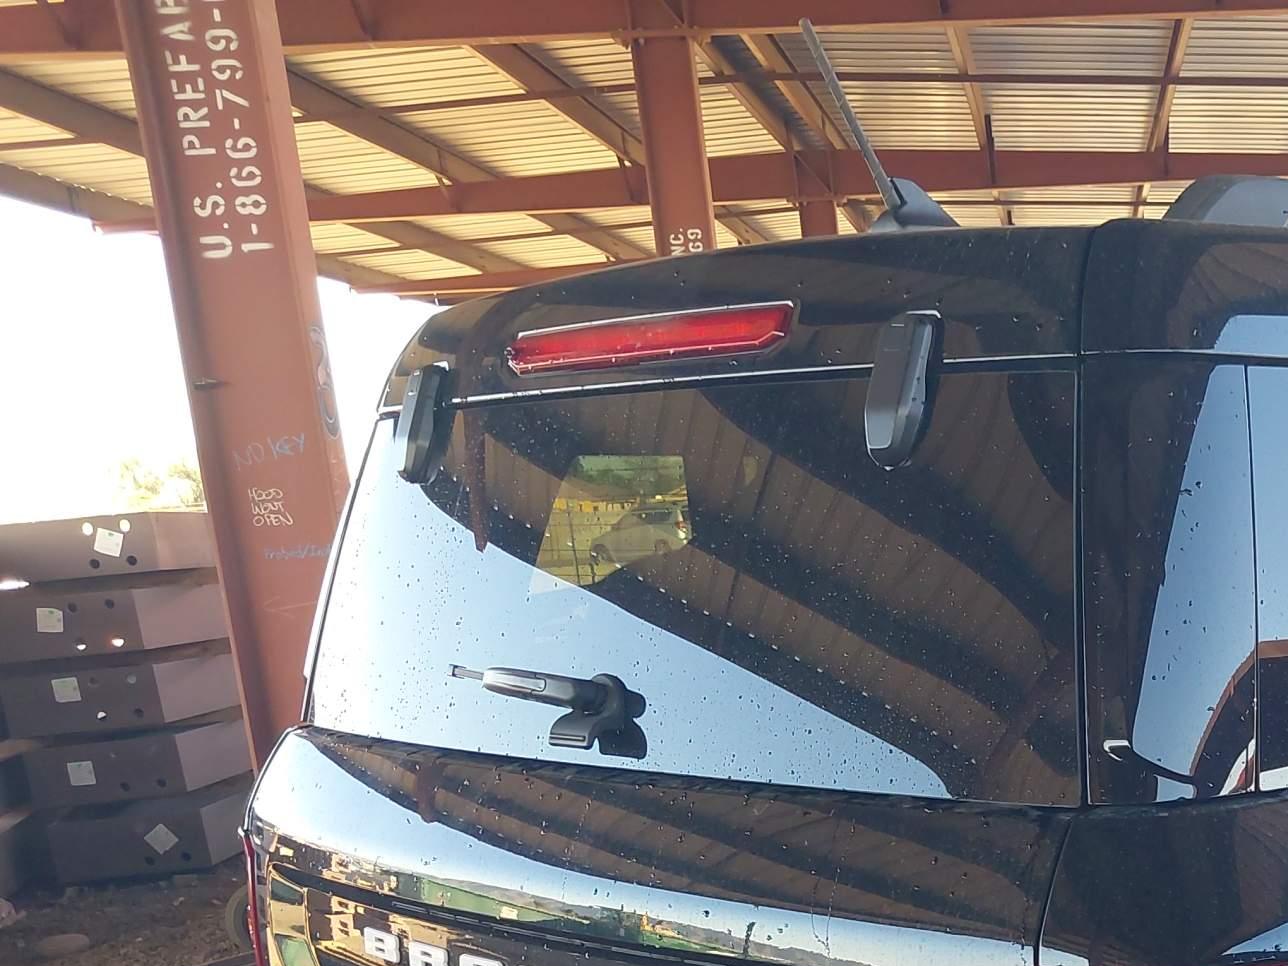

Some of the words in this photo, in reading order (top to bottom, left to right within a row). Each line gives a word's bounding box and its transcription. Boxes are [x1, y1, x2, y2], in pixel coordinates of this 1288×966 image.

[203, 0, 275, 253] 1-866-799-
[193, 182, 233, 259] U.S.
[253, 511, 294, 527] OPEN
